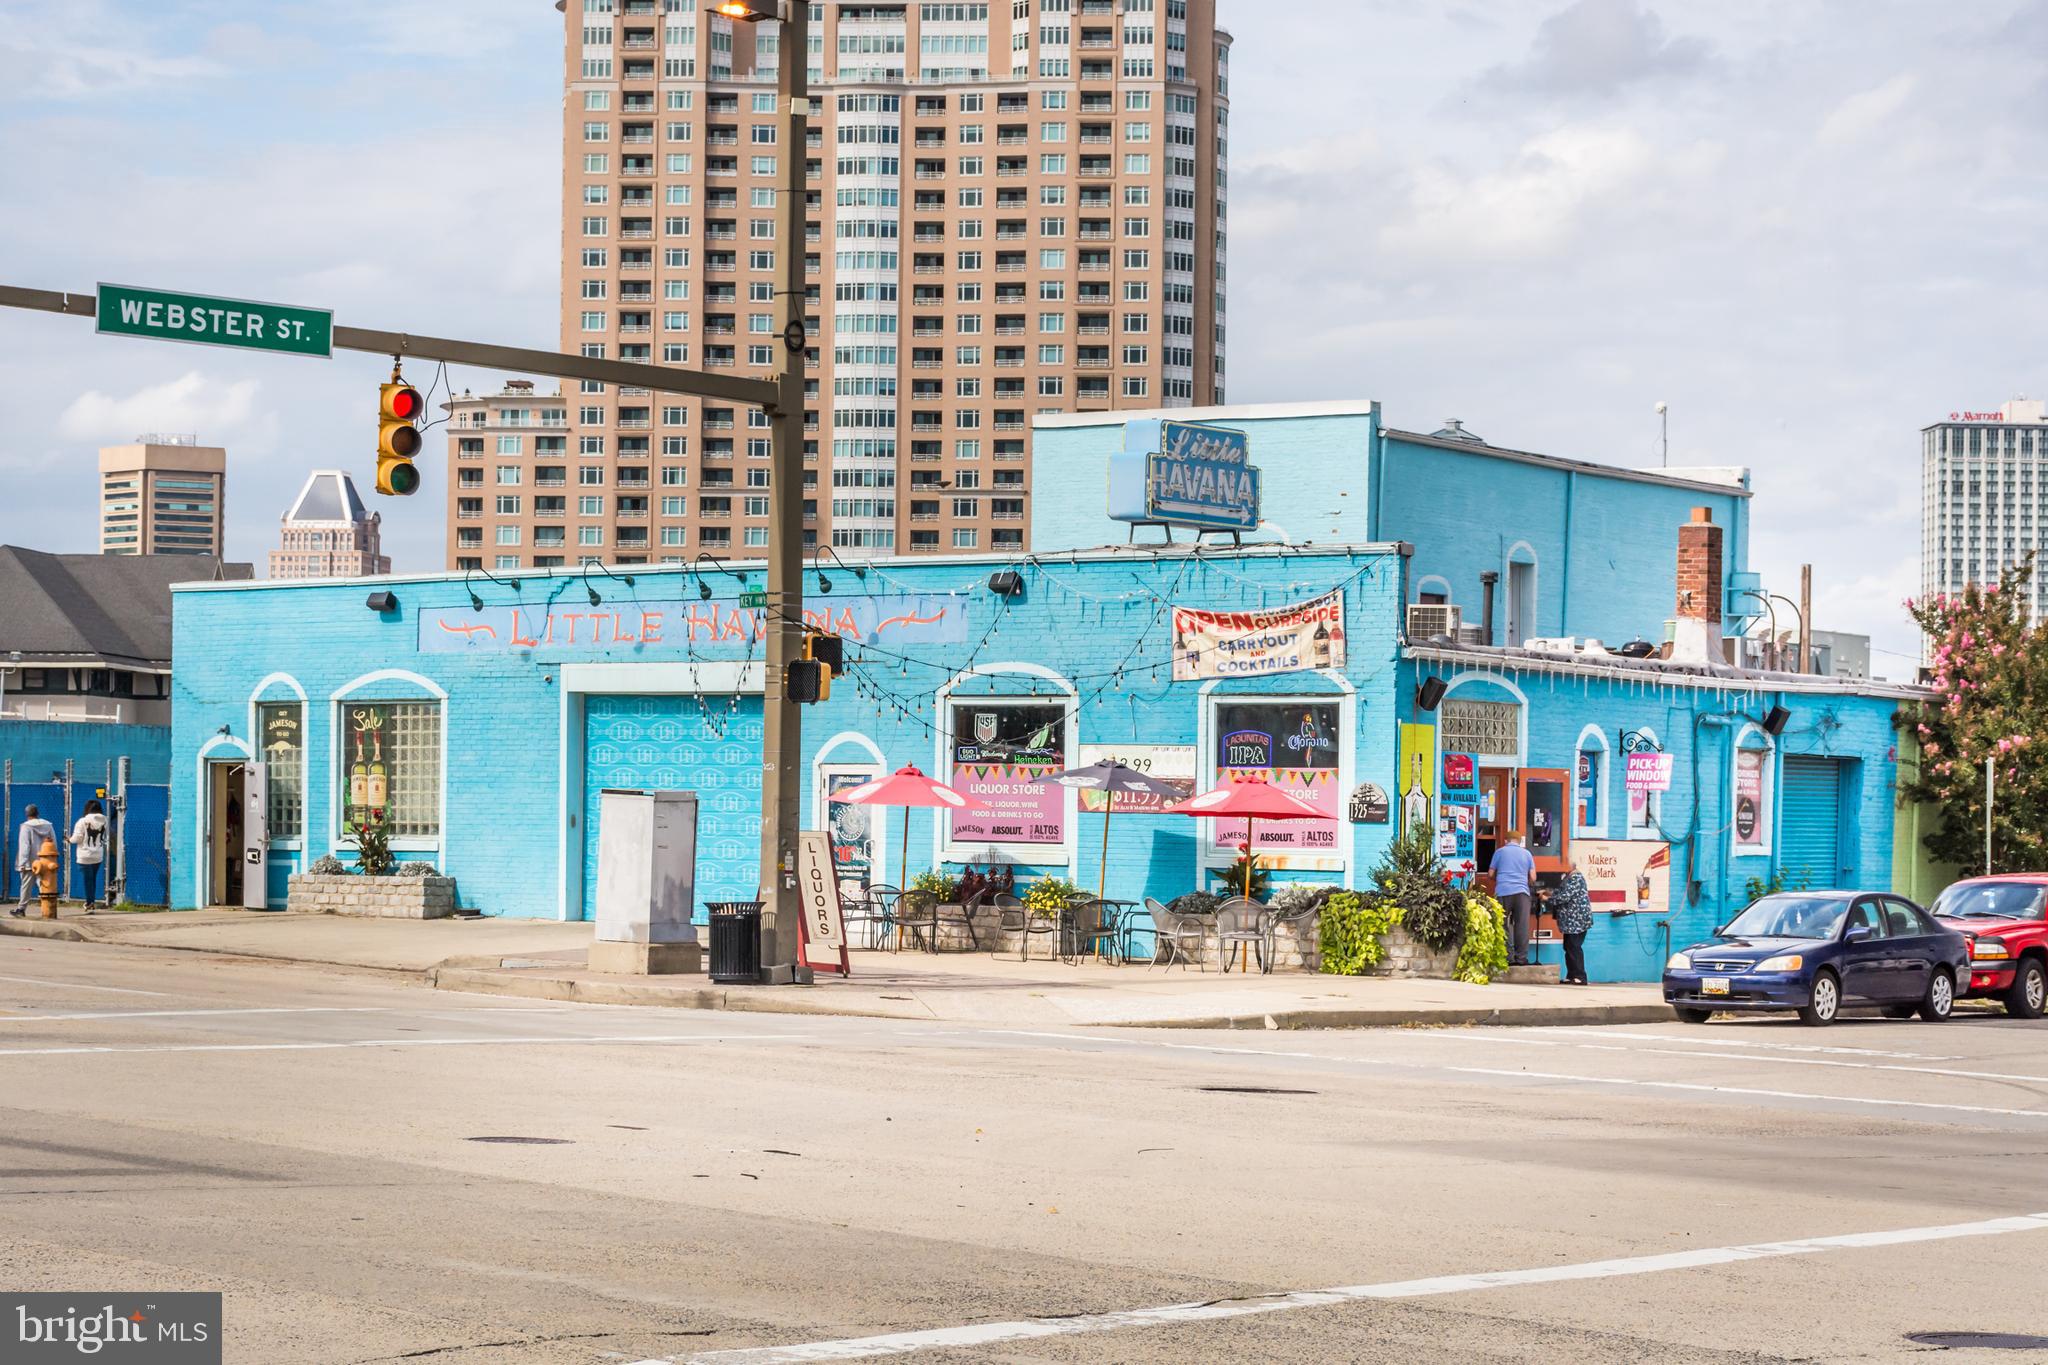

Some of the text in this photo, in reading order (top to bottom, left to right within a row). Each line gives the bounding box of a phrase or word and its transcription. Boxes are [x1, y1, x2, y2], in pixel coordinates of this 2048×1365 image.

[120, 299, 310, 341] WEBSTER ST.
[1167, 427, 1241, 463] Little
[1150, 462, 1254, 507] HAVANA
[740, 595, 752, 607] KEY
[508, 602, 862, 647] LITTLE HAVNA
[1176, 605, 1340, 634] OPEN CURBSIDE
[1218, 633, 1298, 651] CARRYOUT
[1250, 649, 1266, 657] AND
[1217, 656, 1299, 672] COCKTAILS
[268, 719, 297, 730] JAMESON
[353, 708, 382, 731] Sale
[1226, 734, 1269, 748] LAGUNITAS
[1288, 735, 1328, 750] Corona
[1014, 755, 1053, 765] Heineken
[1230, 746, 1266, 764] IPA
[1629, 758, 1668, 769] PICK-UP
[1627, 770, 1670, 781] WINDOW
[970, 784, 1046, 795] LIQUOR STORE
[1350, 803, 1367, 818] 1325
[954, 824, 984, 835] JAMESON
[991, 826, 1023, 835] ABSOLUT.
[1034, 825, 1059, 835] ALTOS
[1218, 831, 1248, 842] JAMESO
[1260, 833, 1294, 842] ABSOLUT.
[1306, 831, 1334, 841] ALTOS
[1588, 855, 1617, 865] Maker's
[1596, 868, 1616, 878] Mark
[807, 842, 830, 935] LIQUORS
